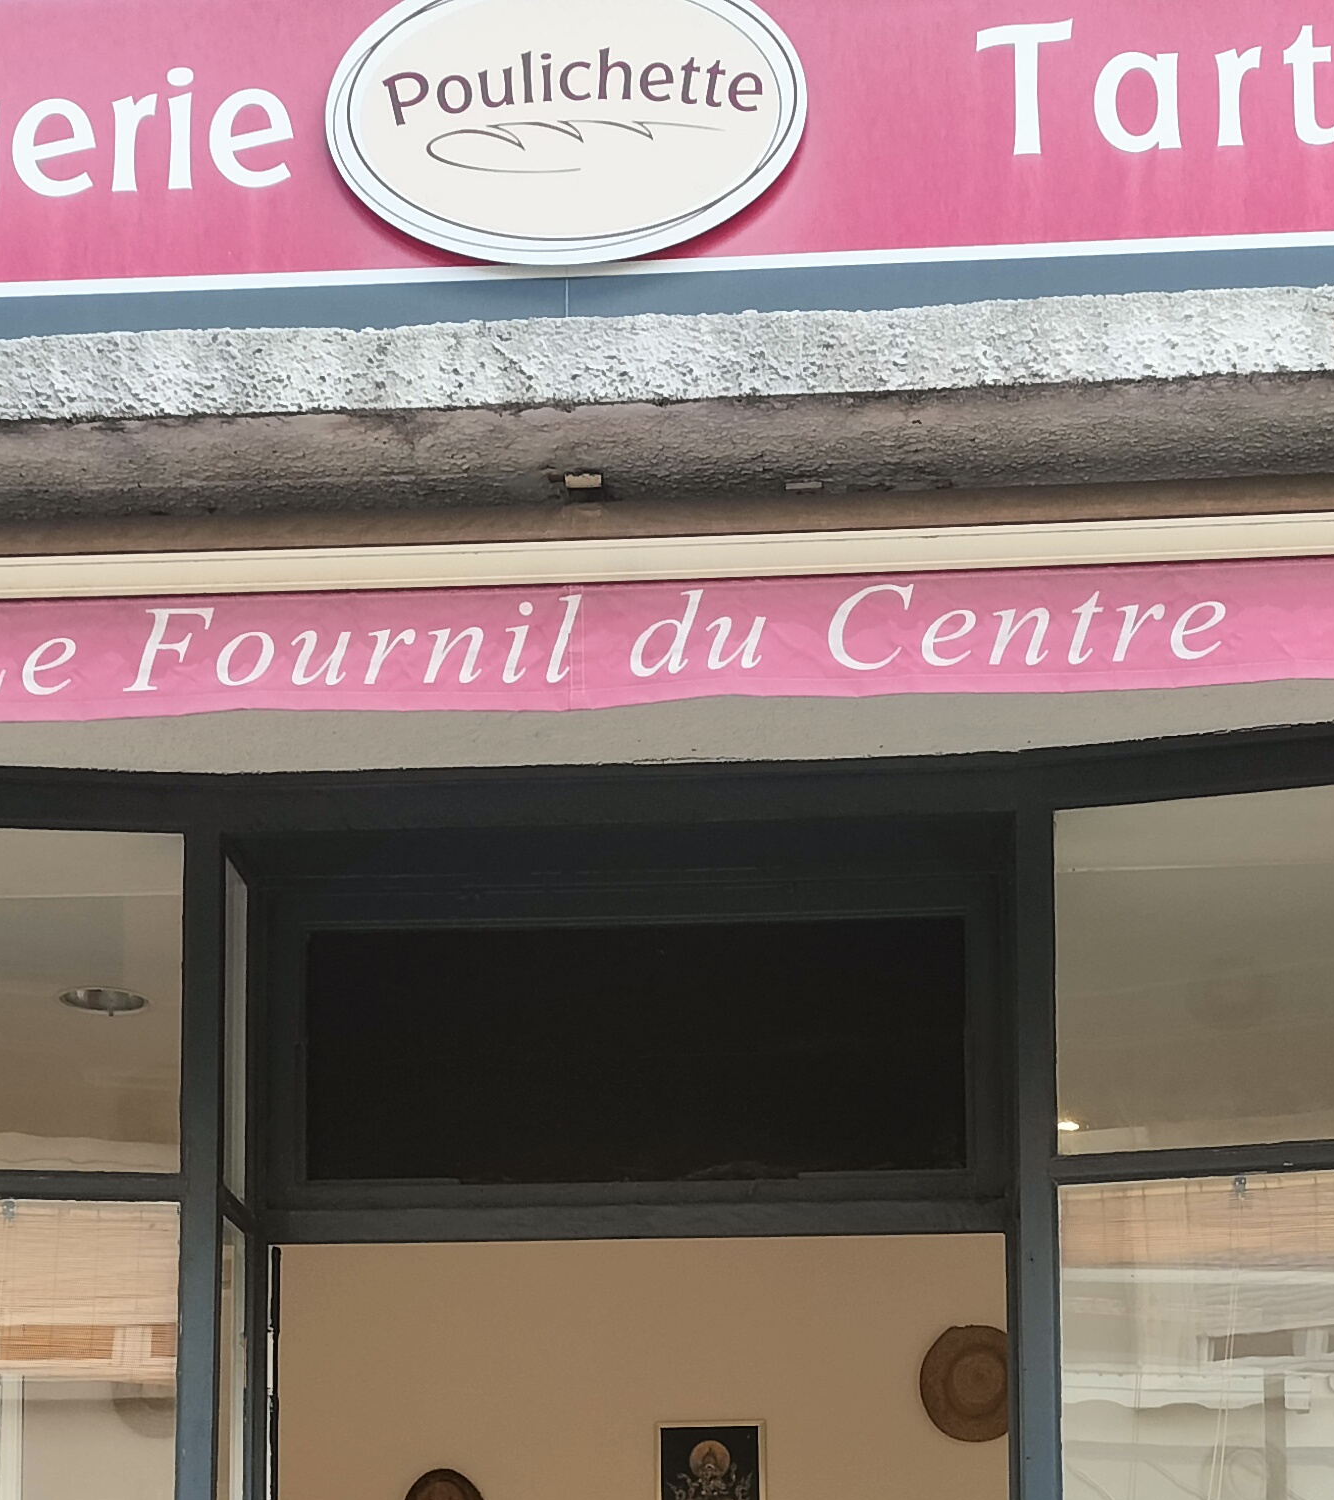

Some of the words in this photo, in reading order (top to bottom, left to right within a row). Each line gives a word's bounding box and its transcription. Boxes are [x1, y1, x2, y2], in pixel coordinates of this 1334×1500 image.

[382, 47, 765, 128] Poulichette
[122, 593, 581, 693] Fournil
[629, 590, 767, 676] du
[826, 583, 1226, 672] Centre
